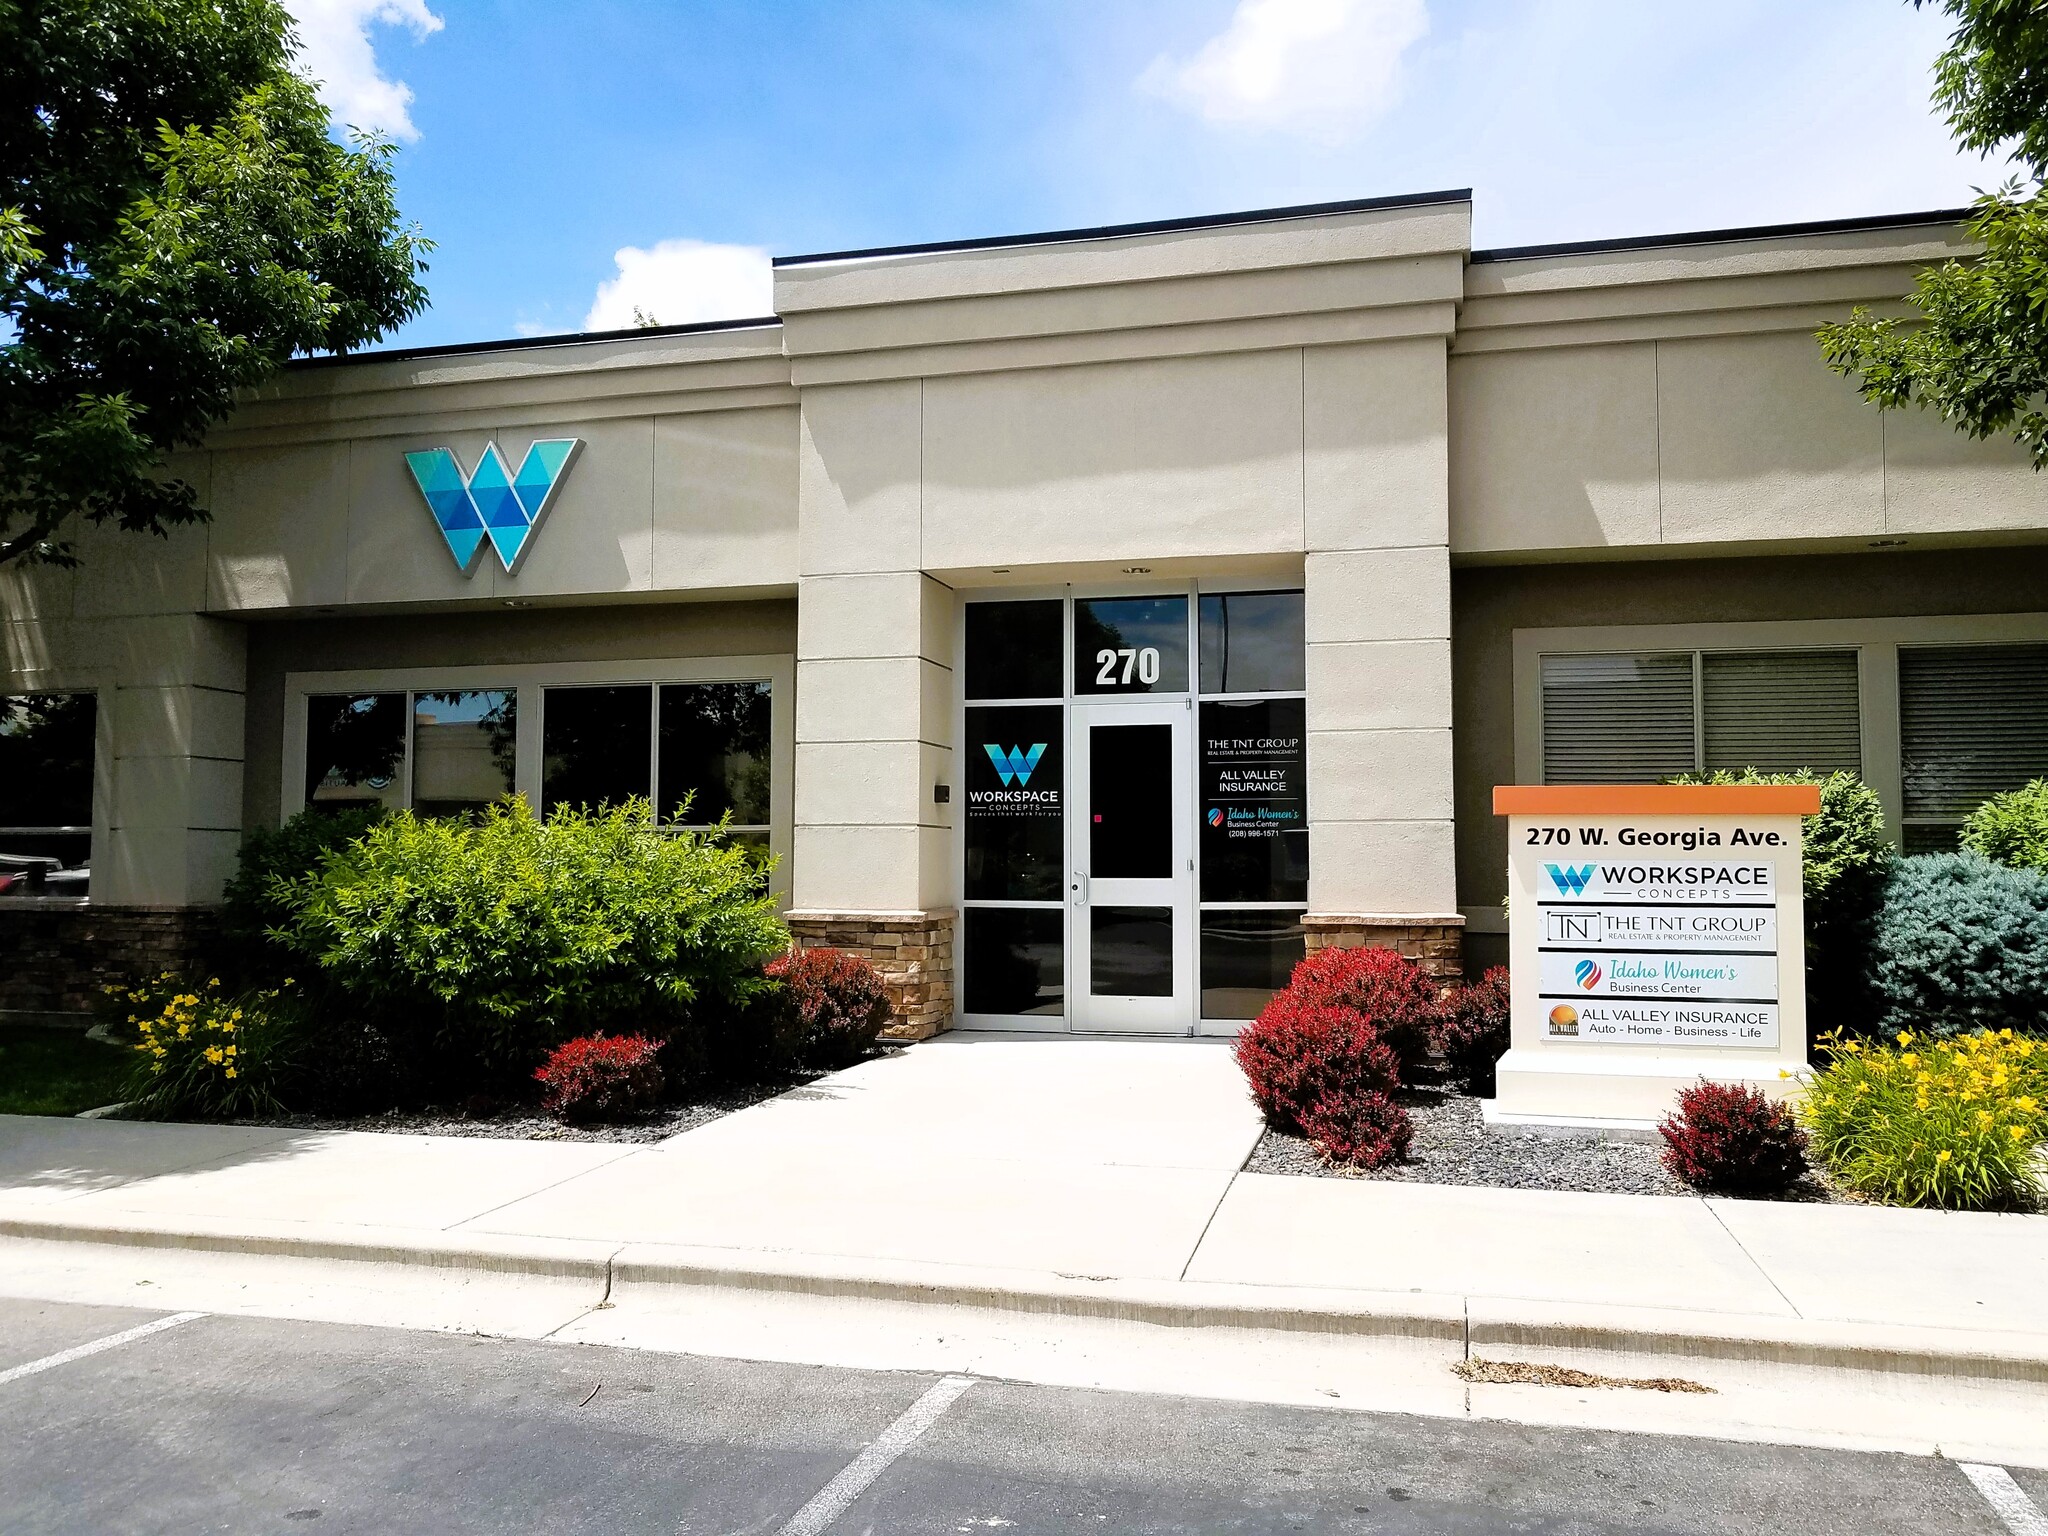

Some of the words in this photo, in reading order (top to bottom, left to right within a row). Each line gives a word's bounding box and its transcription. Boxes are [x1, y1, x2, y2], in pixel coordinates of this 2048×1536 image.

[1096, 647, 1160, 685] 270
[1207, 739, 1229, 749] THE
[1231, 739, 1254, 748] TNT
[1256, 738, 1299, 748] GROUP
[1219, 770, 1241, 780] ALL
[1241, 769, 1286, 780] VALLEY
[1219, 781, 1287, 792] INSURANCE
[969, 791, 1058, 802] WORKSPACE
[1227, 807, 1256, 820] Idaho
[1257, 807, 1300, 820] Women's
[1227, 820, 1256, 828] Business
[1255, 820, 1279, 828] Center
[1228, 830, 1247, 839] (208)
[1526, 828, 1571, 846] 270
[1578, 828, 1609, 846] W.
[1617, 827, 1721, 851] Georgia
[1730, 828, 1788, 846] Ave.
[1601, 866, 1768, 885] WORKSPACE
[1637, 888, 1731, 899] CONCEPTS
[1603, 916, 1641, 930] THE
[1646, 916, 1686, 931] TNT
[1692, 917, 1766, 932] GROUP
[1703, 934, 1762, 942] MANAGEMENT
[1609, 959, 1659, 979] Idaho
[1664, 960, 1738, 980] Women's
[1610, 982, 1659, 993] Business
[1661, 983, 1702, 994] Center
[1581, 1009, 1609, 1021] ALL
[1612, 1010, 1670, 1022] VALLEY
[1675, 1011, 1769, 1025] INSURANCE
[1549, 1024, 1559, 1032] ALL
[1589, 1023, 1616, 1034] Auto
[1627, 1025, 1662, 1035] Home
[1674, 1026, 1728, 1037] Business
[1740, 1028, 1762, 1038] Life
